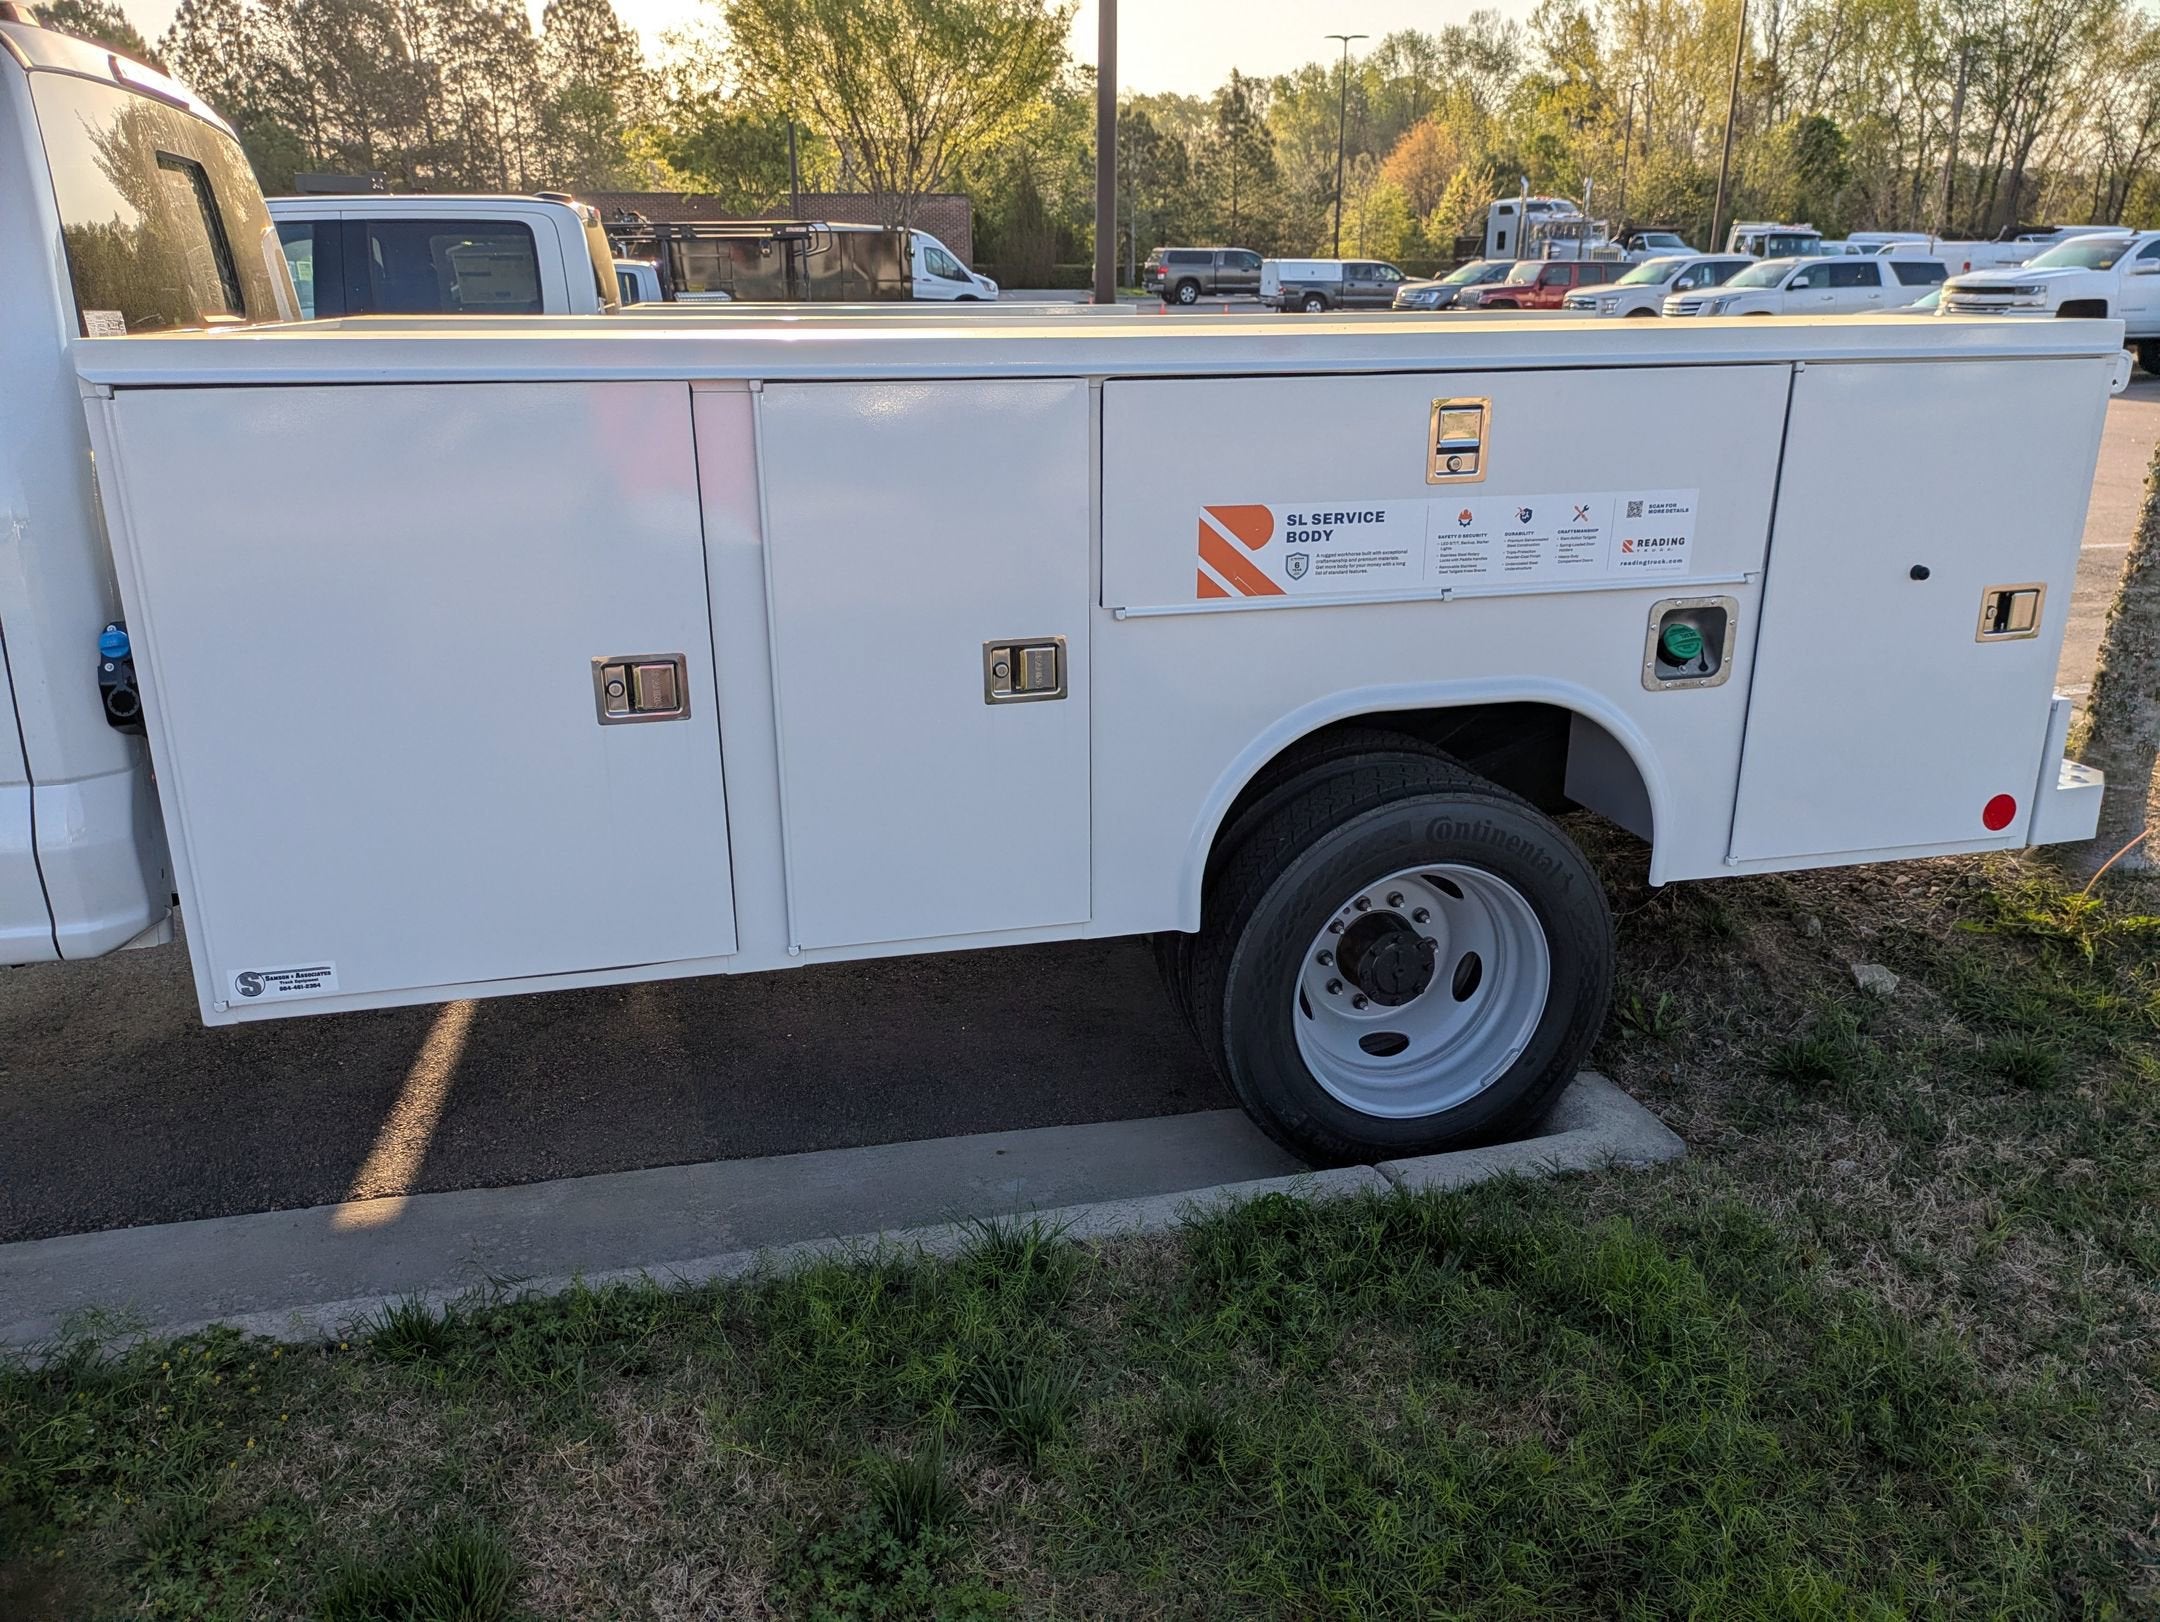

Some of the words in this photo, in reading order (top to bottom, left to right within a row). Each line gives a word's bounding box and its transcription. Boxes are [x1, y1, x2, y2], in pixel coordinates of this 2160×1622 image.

[1286, 514, 1307, 526] SL
[1311, 511, 1385, 525] SERVICE
[1286, 529, 1334, 543] BODY
[1637, 537, 1685, 547] READING
[1425, 815, 1564, 879] Continental
